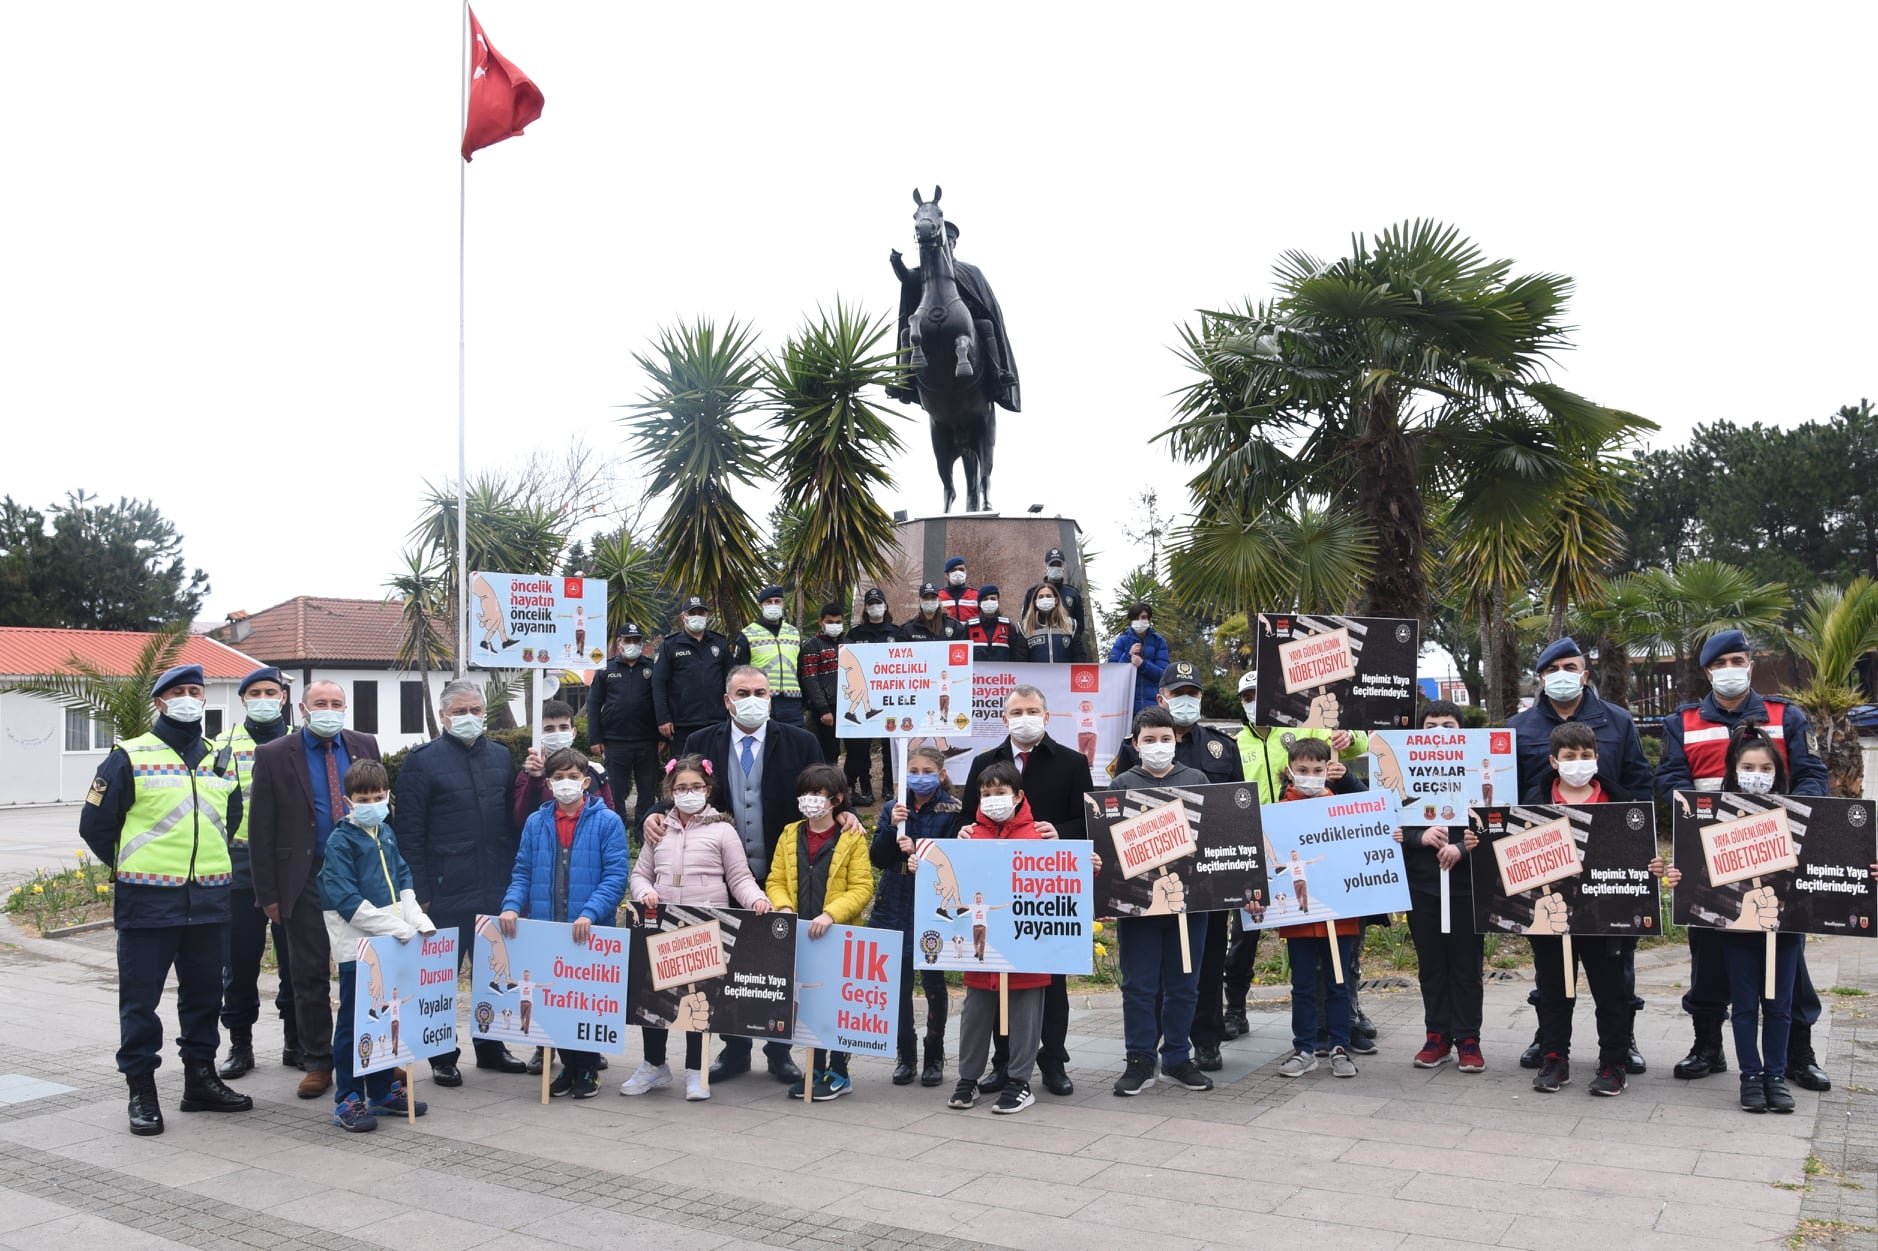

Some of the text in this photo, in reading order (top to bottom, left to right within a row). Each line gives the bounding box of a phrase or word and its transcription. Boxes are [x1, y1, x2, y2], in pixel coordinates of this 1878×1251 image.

[511, 578, 552, 593] öncelik
[510, 592, 555, 609] hayatın
[510, 606, 552, 621] öncelik
[510, 622, 556, 636] yayanın
[888, 647, 914, 659] YAYA
[1288, 649, 1303, 662] YAYA
[873, 660, 928, 675] ÖNCELİKLİ
[1288, 649, 1349, 685] NÖBETÇİSİYİZ
[870, 675, 930, 692] TRAFİK İÇİN
[1361, 673, 1410, 688] Hepimiz Yaya
[882, 694, 916, 706] EL ELE
[1353, 686, 1410, 700] Geçitlerindeyiz.
[1406, 735, 1466, 748] ARAÇLAR
[1242, 751, 1257, 764] LİS
[1409, 750, 1464, 761] DURSUN
[1408, 766, 1466, 777] YAYALAR
[1413, 779, 1462, 797] GEÇSİN
[1328, 797, 1387, 818] unutma!
[1121, 827, 1138, 844] YAYA
[1299, 821, 1391, 846] sevdiklerinde
[1712, 833, 1731, 848] YAYA
[1123, 823, 1189, 869] NÖBETÇİSİYİZ
[1204, 844, 1257, 859] Hepimiz Yaya
[1504, 845, 1522, 859] YAYA
[1713, 833, 1790, 875] NÖBETÇİSİYİZ
[1012, 850, 1078, 872] öncelik
[1363, 847, 1395, 866] yaya
[1506, 842, 1574, 885] NÖBETÇİSİYİZ
[1197, 859, 1259, 874] Geçitlerindeyiz.
[1806, 863, 1868, 879] Hepimiz Yaya
[1343, 869, 1399, 893] yolunda
[1591, 868, 1649, 883] Hepimiz Yaya
[1011, 872, 1082, 899] hayatın
[1581, 882, 1650, 897] Geçitlerindeyiz.
[1796, 879, 1869, 895] Geçitlerindeyiz.
[1012, 895, 1078, 917] öncelik
[1014, 920, 1082, 940] yayanın
[421, 936, 456, 959] Araçlar
[587, 934, 622, 957] Yaya
[656, 942, 672, 957] YAYA
[656, 944, 720, 981] NÖBETÇİSİYİZ
[842, 930, 889, 983] İlk
[420, 968, 454, 986] Dursun
[553, 956, 621, 984] Öncelikli
[734, 972, 787, 988] Hepimiz Yaya
[724, 985, 786, 1002] Geçitlerindeyiz.
[841, 982, 888, 1011] Geçiş
[418, 994, 454, 1018] Yayalar
[542, 988, 619, 1017] Trafik için
[837, 1009, 889, 1035] Hakkı
[423, 1025, 452, 1047] Geçsin
[577, 1022, 618, 1044] El Ele
[837, 1035, 887, 1052] Yayanındır!
